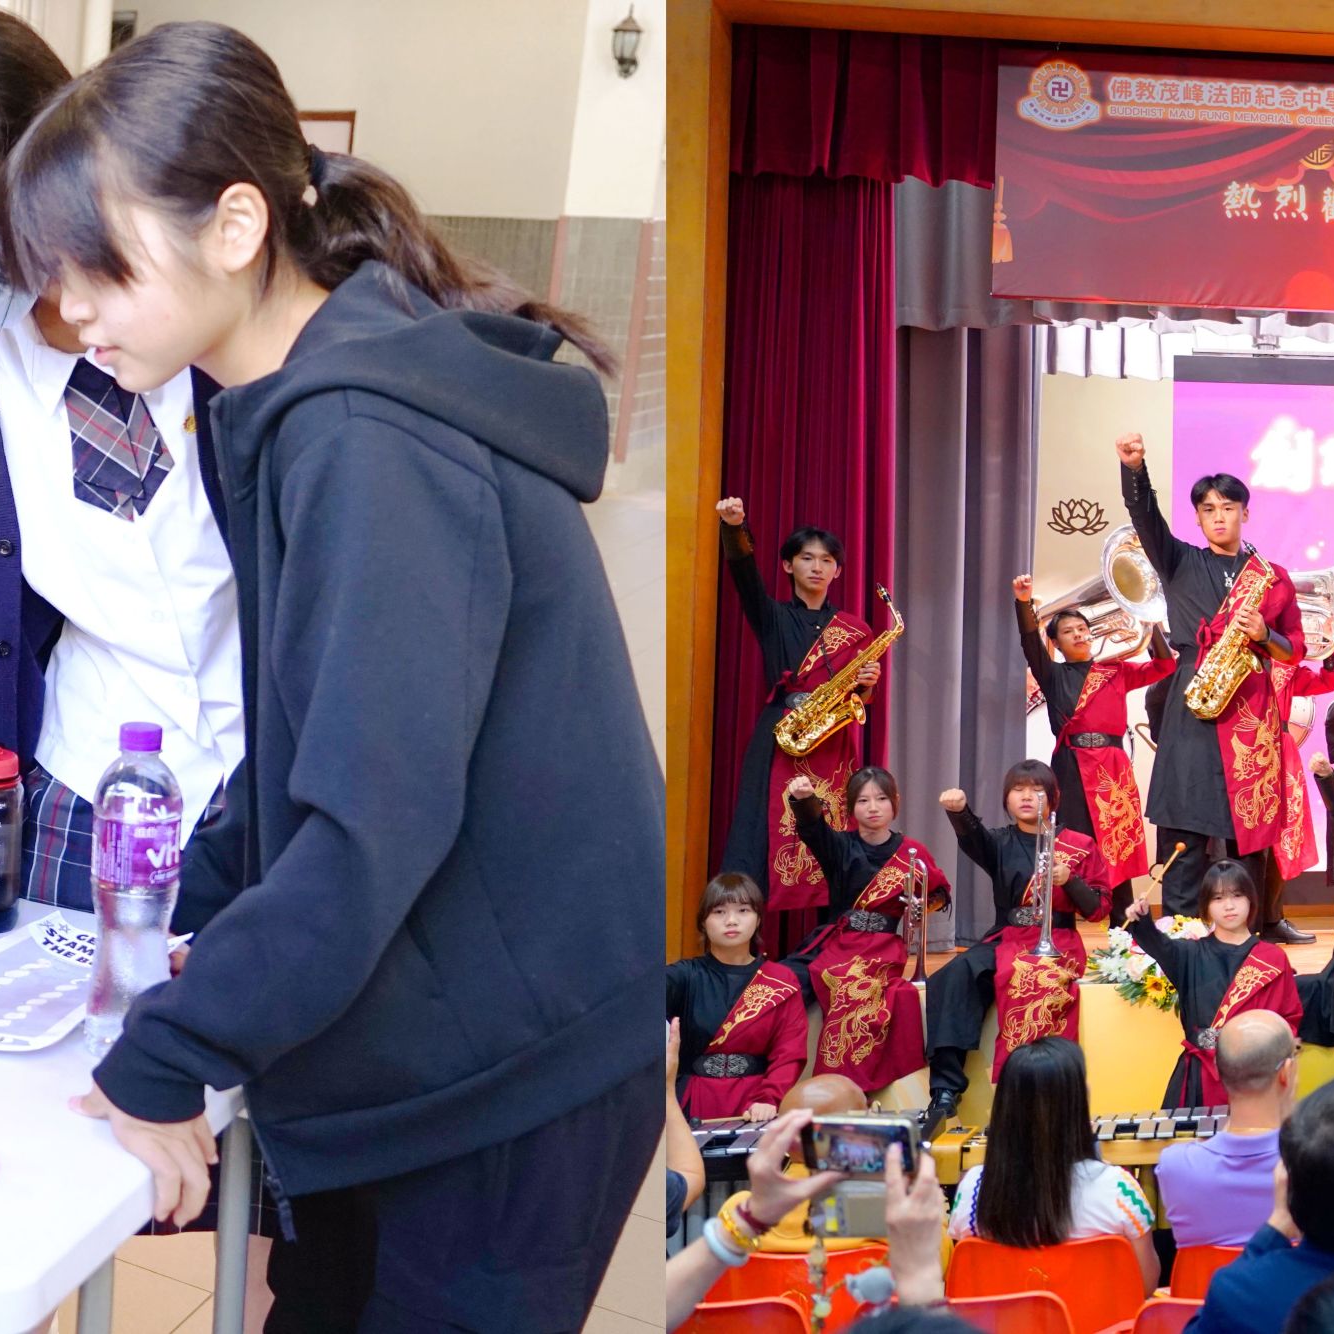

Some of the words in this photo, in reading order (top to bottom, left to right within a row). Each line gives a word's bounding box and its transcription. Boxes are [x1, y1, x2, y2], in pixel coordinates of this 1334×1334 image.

[1110, 106, 1164, 118] BUDDHIST
[1169, 109, 1195, 120] MAU
[1200, 110, 1230, 121] FUNG
[1234, 112, 1292, 124] MEMORIAL
[42, 937, 76, 958] THE
[45, 928, 95, 956] STAM
[76, 934, 97, 945] GE
